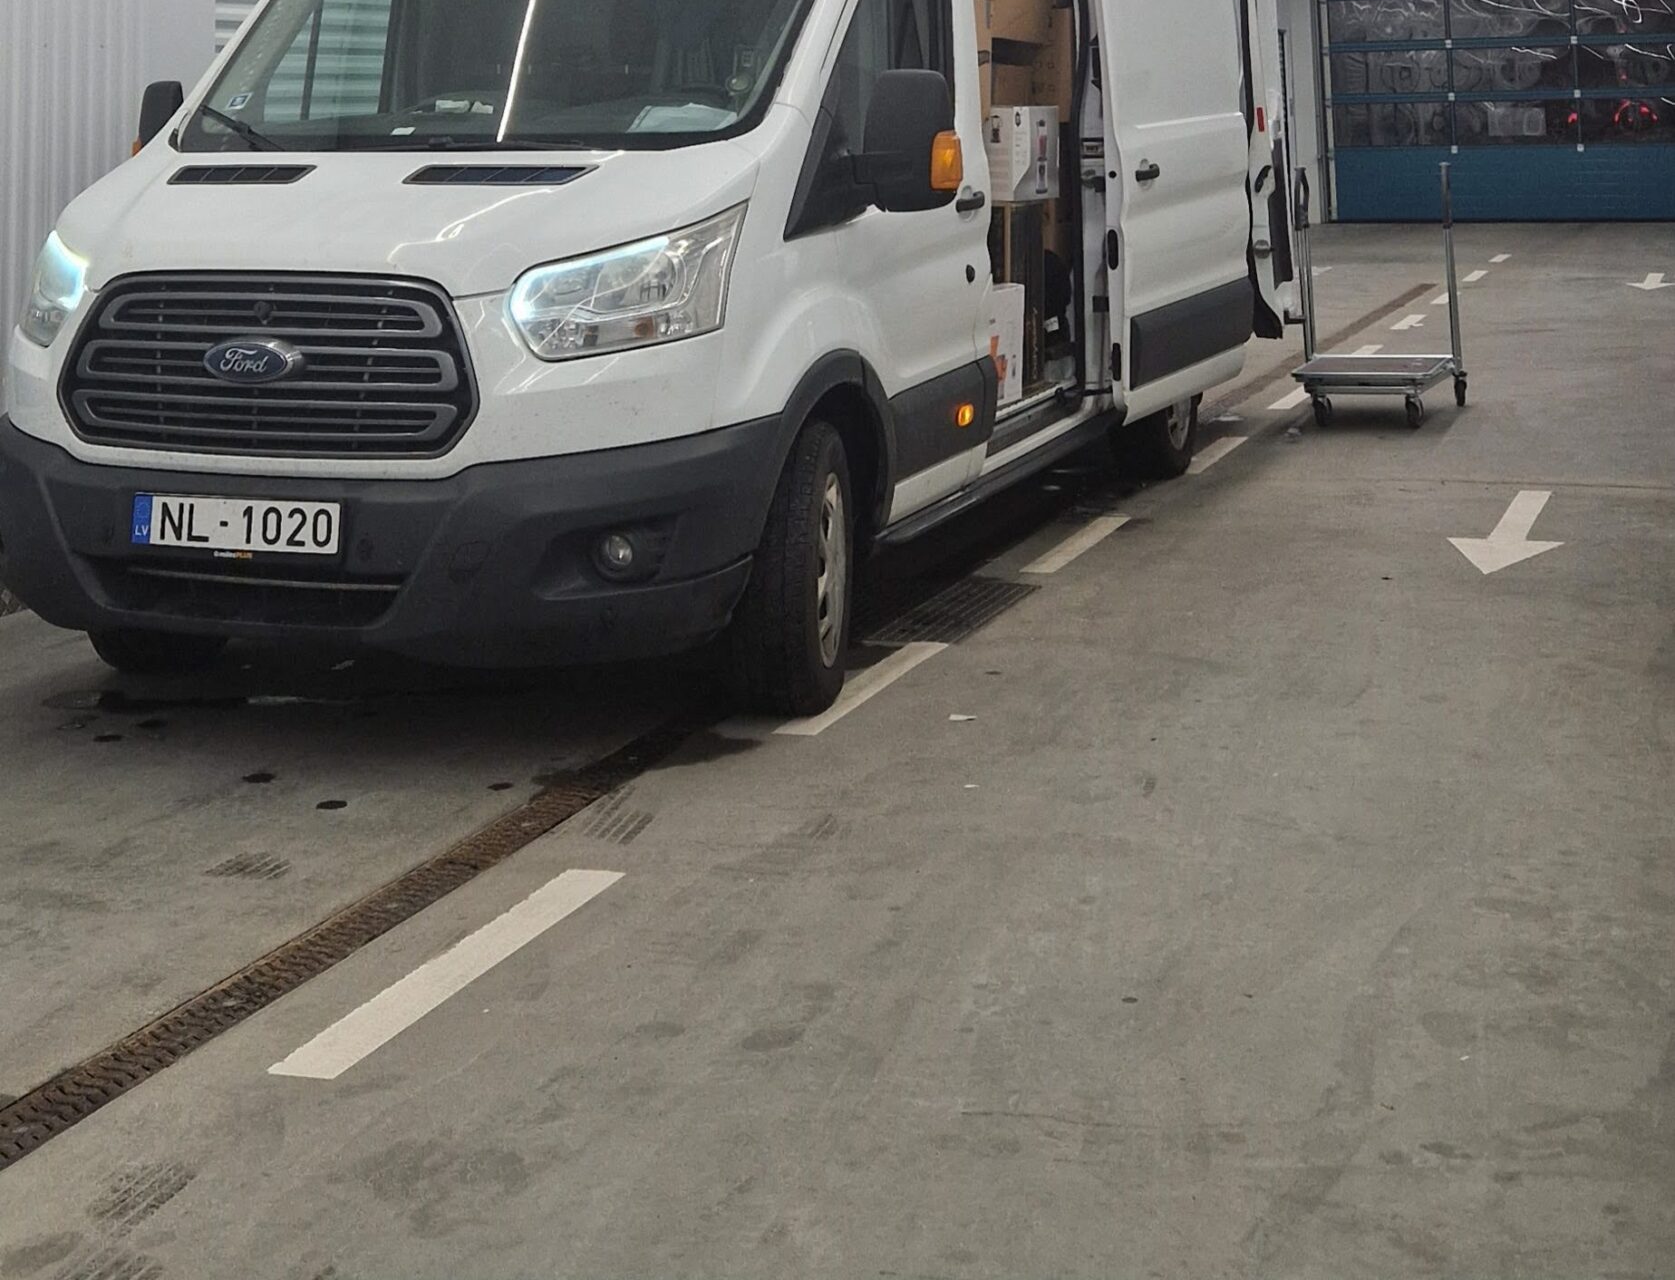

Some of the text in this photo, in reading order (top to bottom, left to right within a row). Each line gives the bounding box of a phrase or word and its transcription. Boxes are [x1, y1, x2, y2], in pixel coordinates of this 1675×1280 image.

[220, 347, 269, 373] Ford
[135, 524, 149, 537] LV
[160, 502, 333, 548] NL-1020
